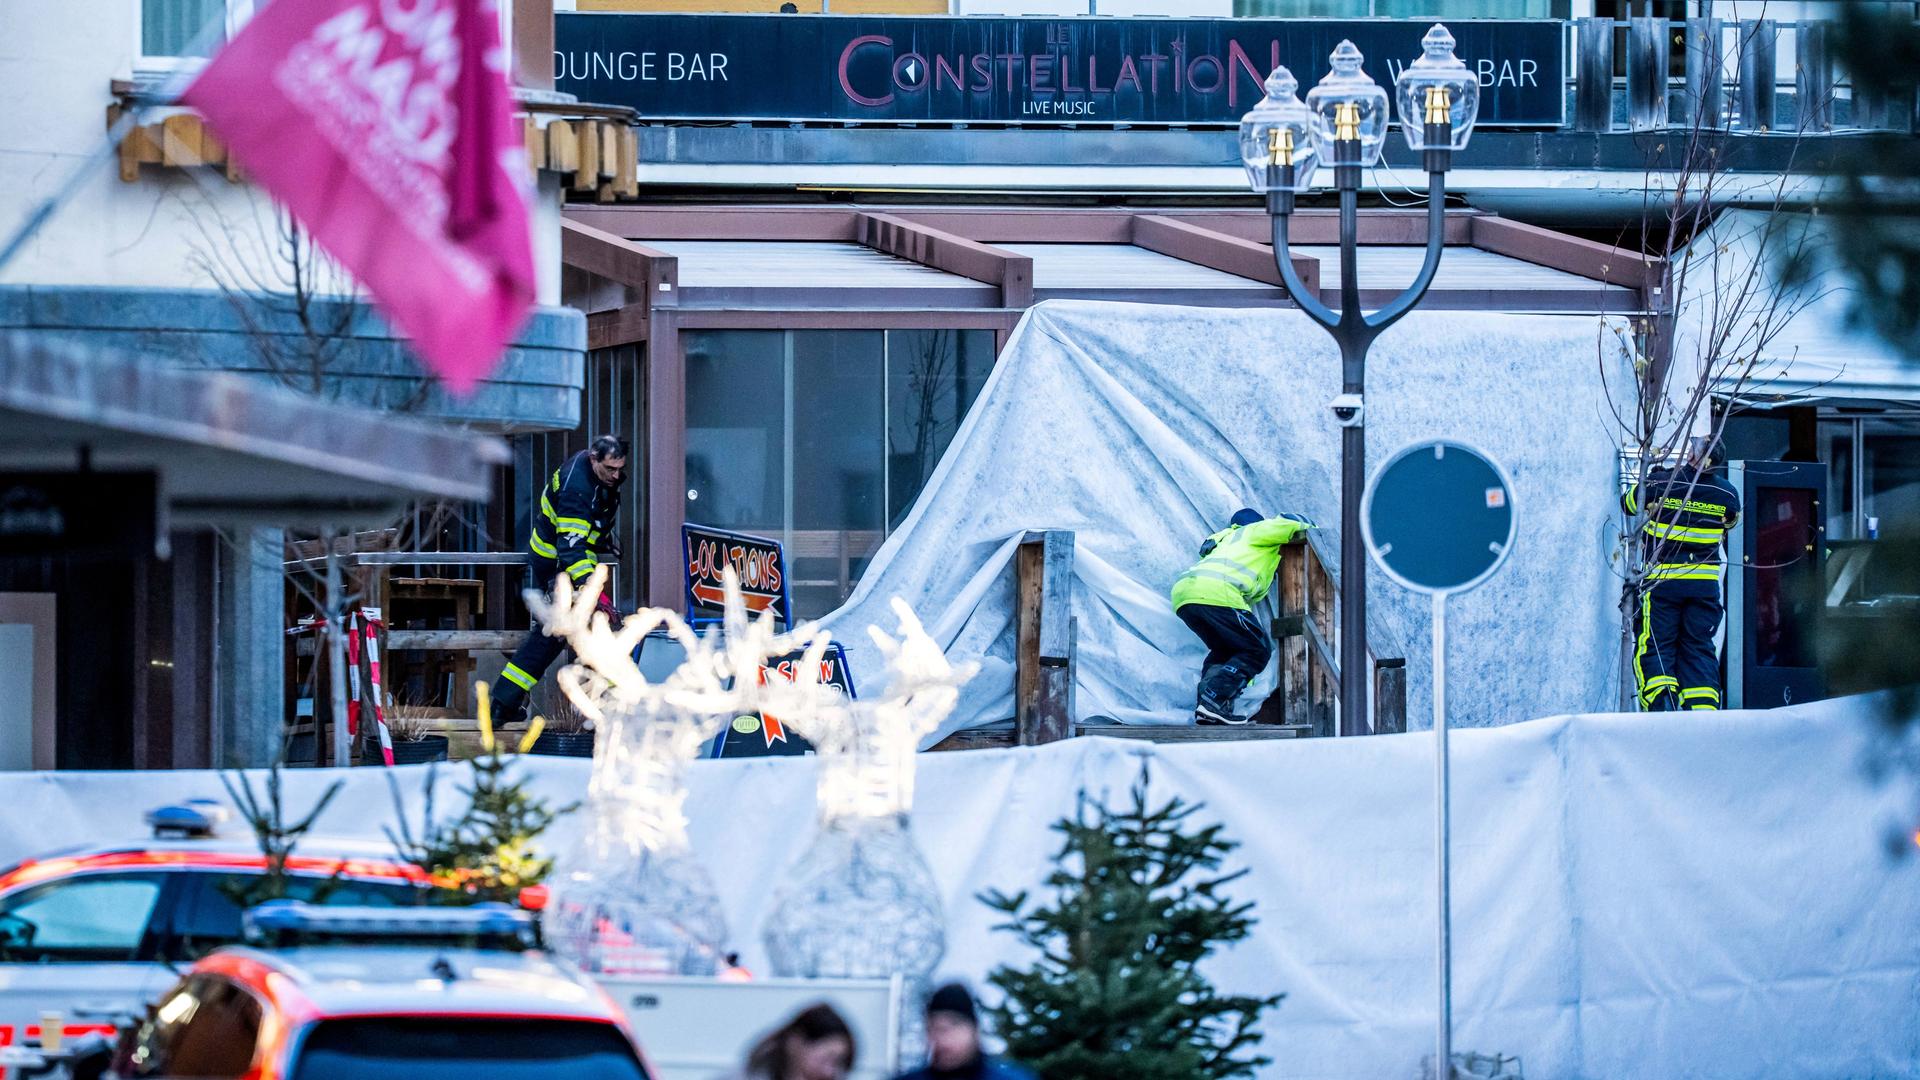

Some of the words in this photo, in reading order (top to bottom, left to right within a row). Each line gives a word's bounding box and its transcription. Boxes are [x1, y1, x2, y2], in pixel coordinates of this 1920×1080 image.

[1046, 23, 1070, 45] LE
[553, 51, 657, 81] OUNGE
[668, 52, 728, 81] BAR
[1477, 59, 1538, 88] BAR
[1022, 101, 1050, 115] LIVE
[1053, 101, 1096, 115] MUSIC
[1659, 496, 1727, 513] APER-POMPIER
[777, 659, 834, 685] SW
